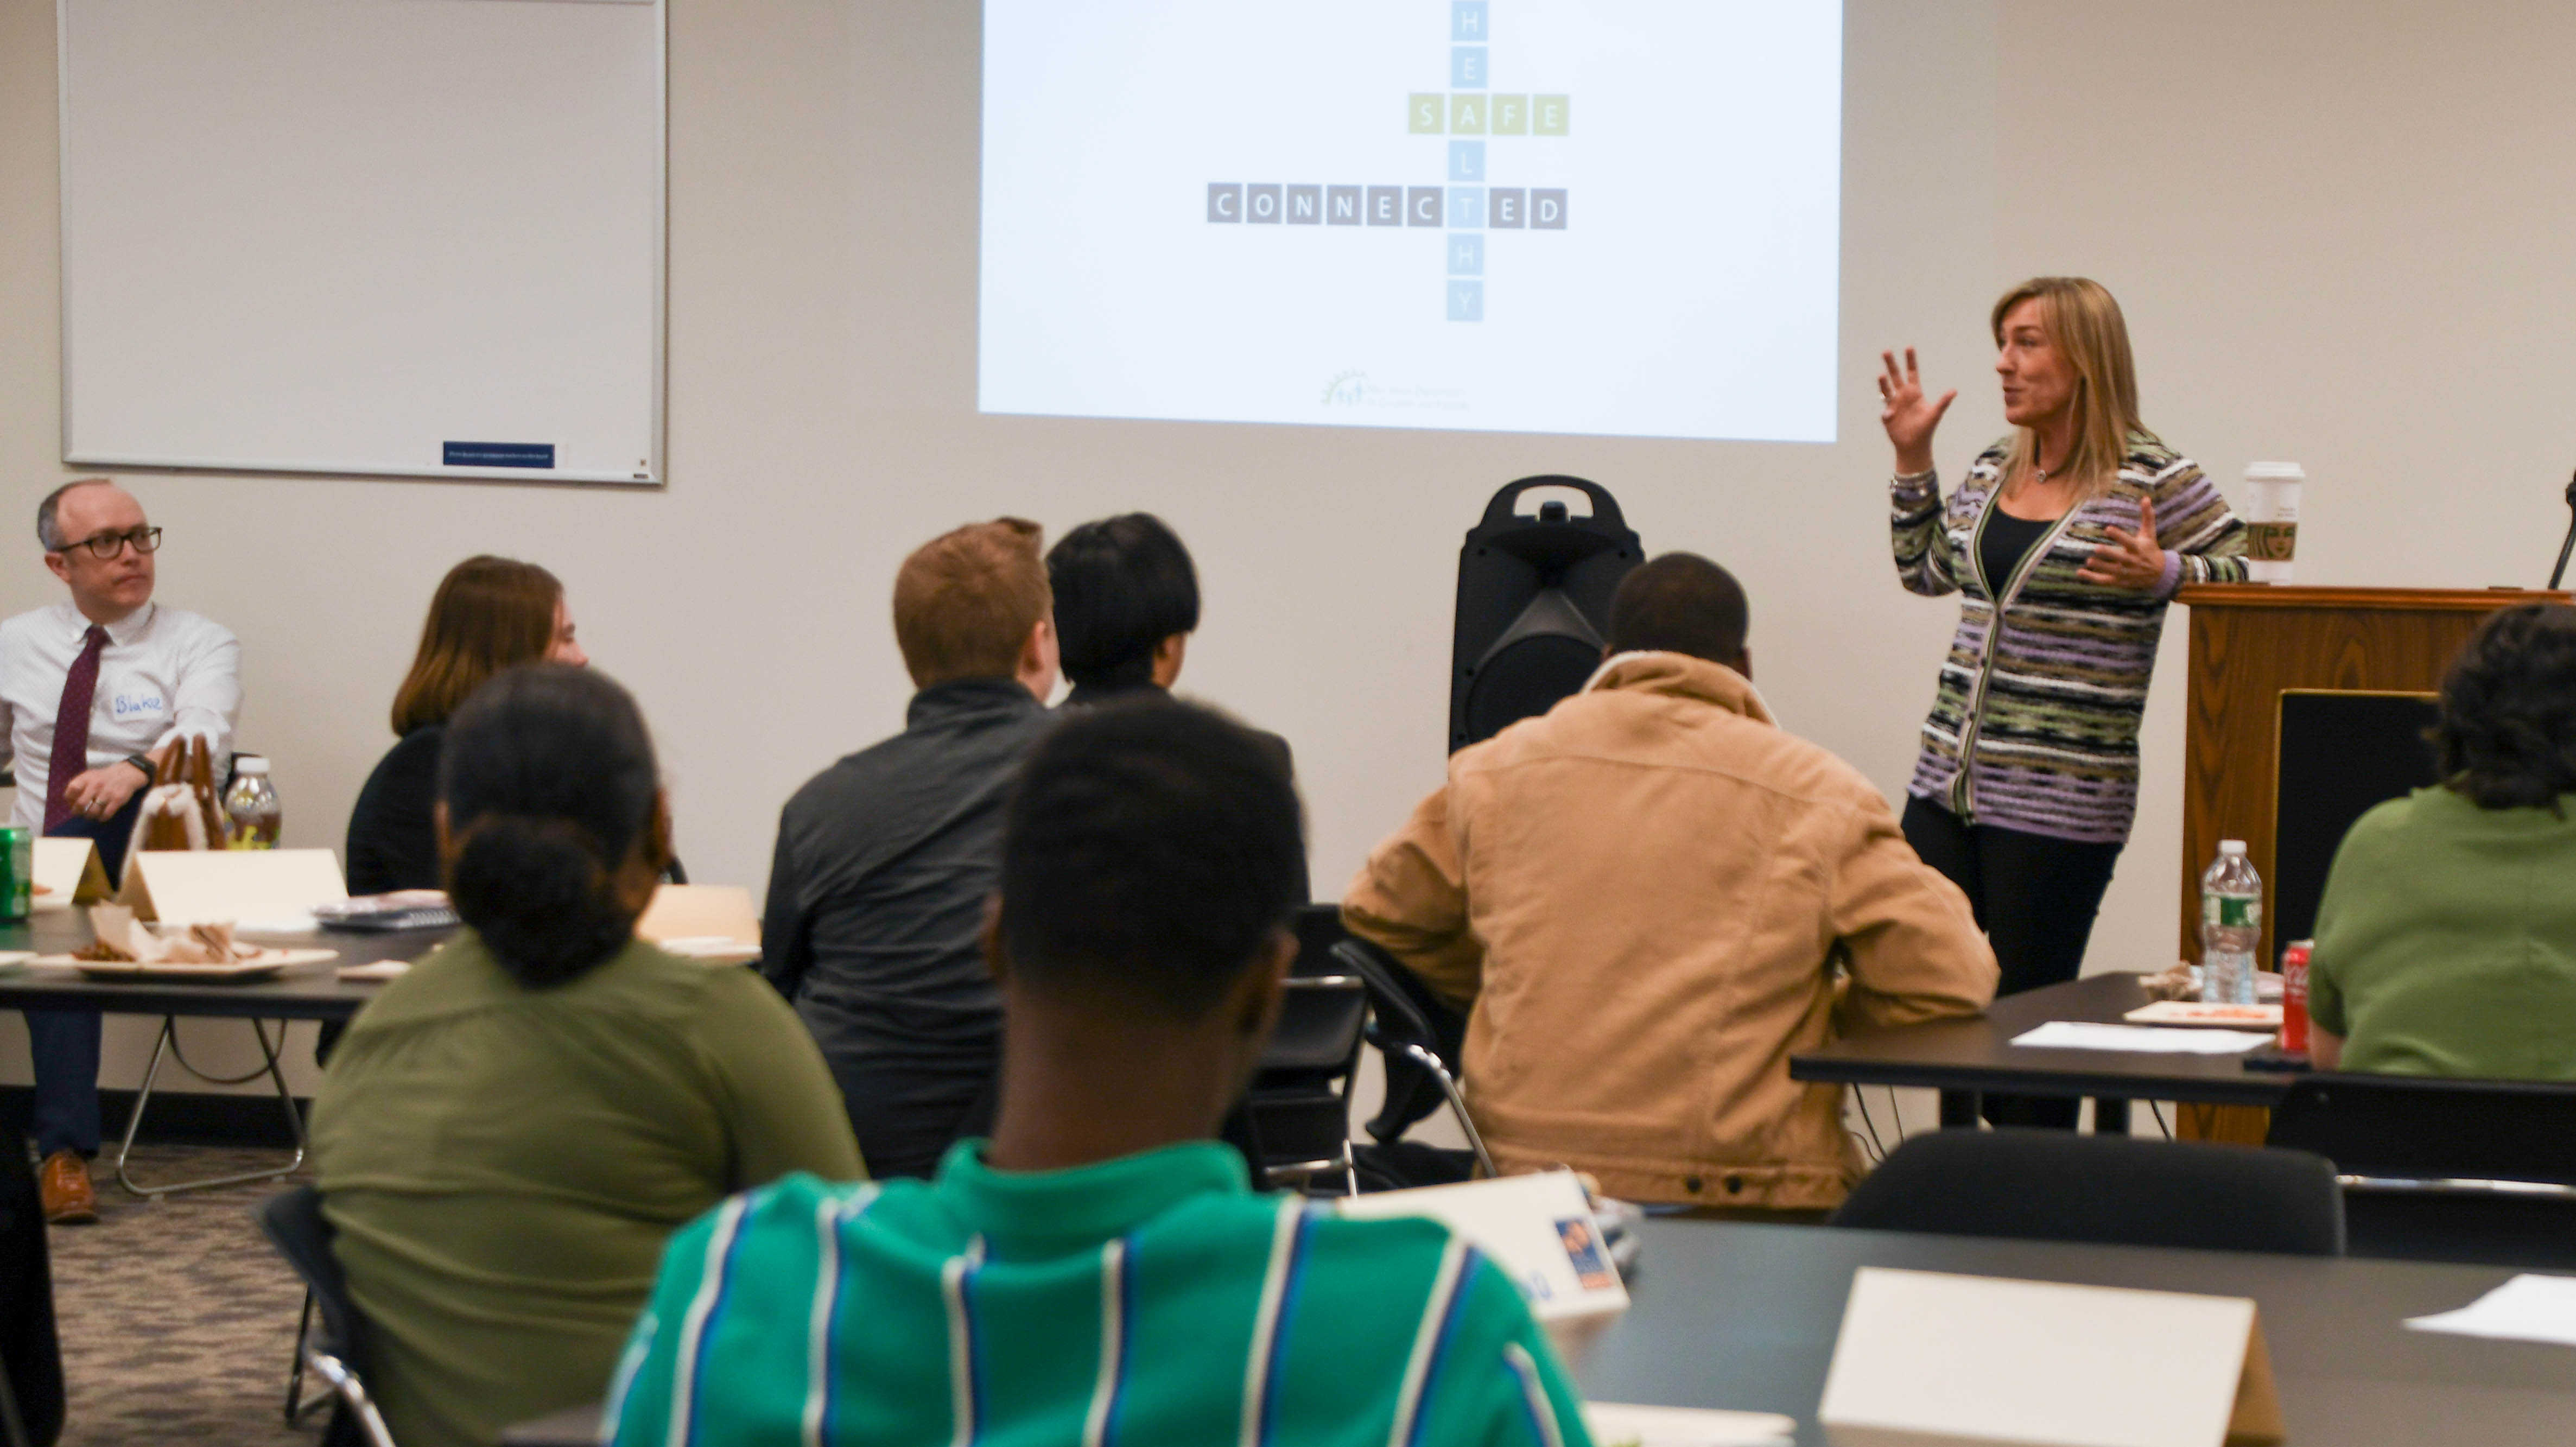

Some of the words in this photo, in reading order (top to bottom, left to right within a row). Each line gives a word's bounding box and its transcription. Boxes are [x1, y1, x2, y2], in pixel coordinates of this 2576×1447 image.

[1419, 101, 1558, 130] SAFE
[1456, 9, 1481, 314] HEALTHY
[1216, 192, 1559, 223] CONNECTED
[116, 694, 162, 714] Blake
